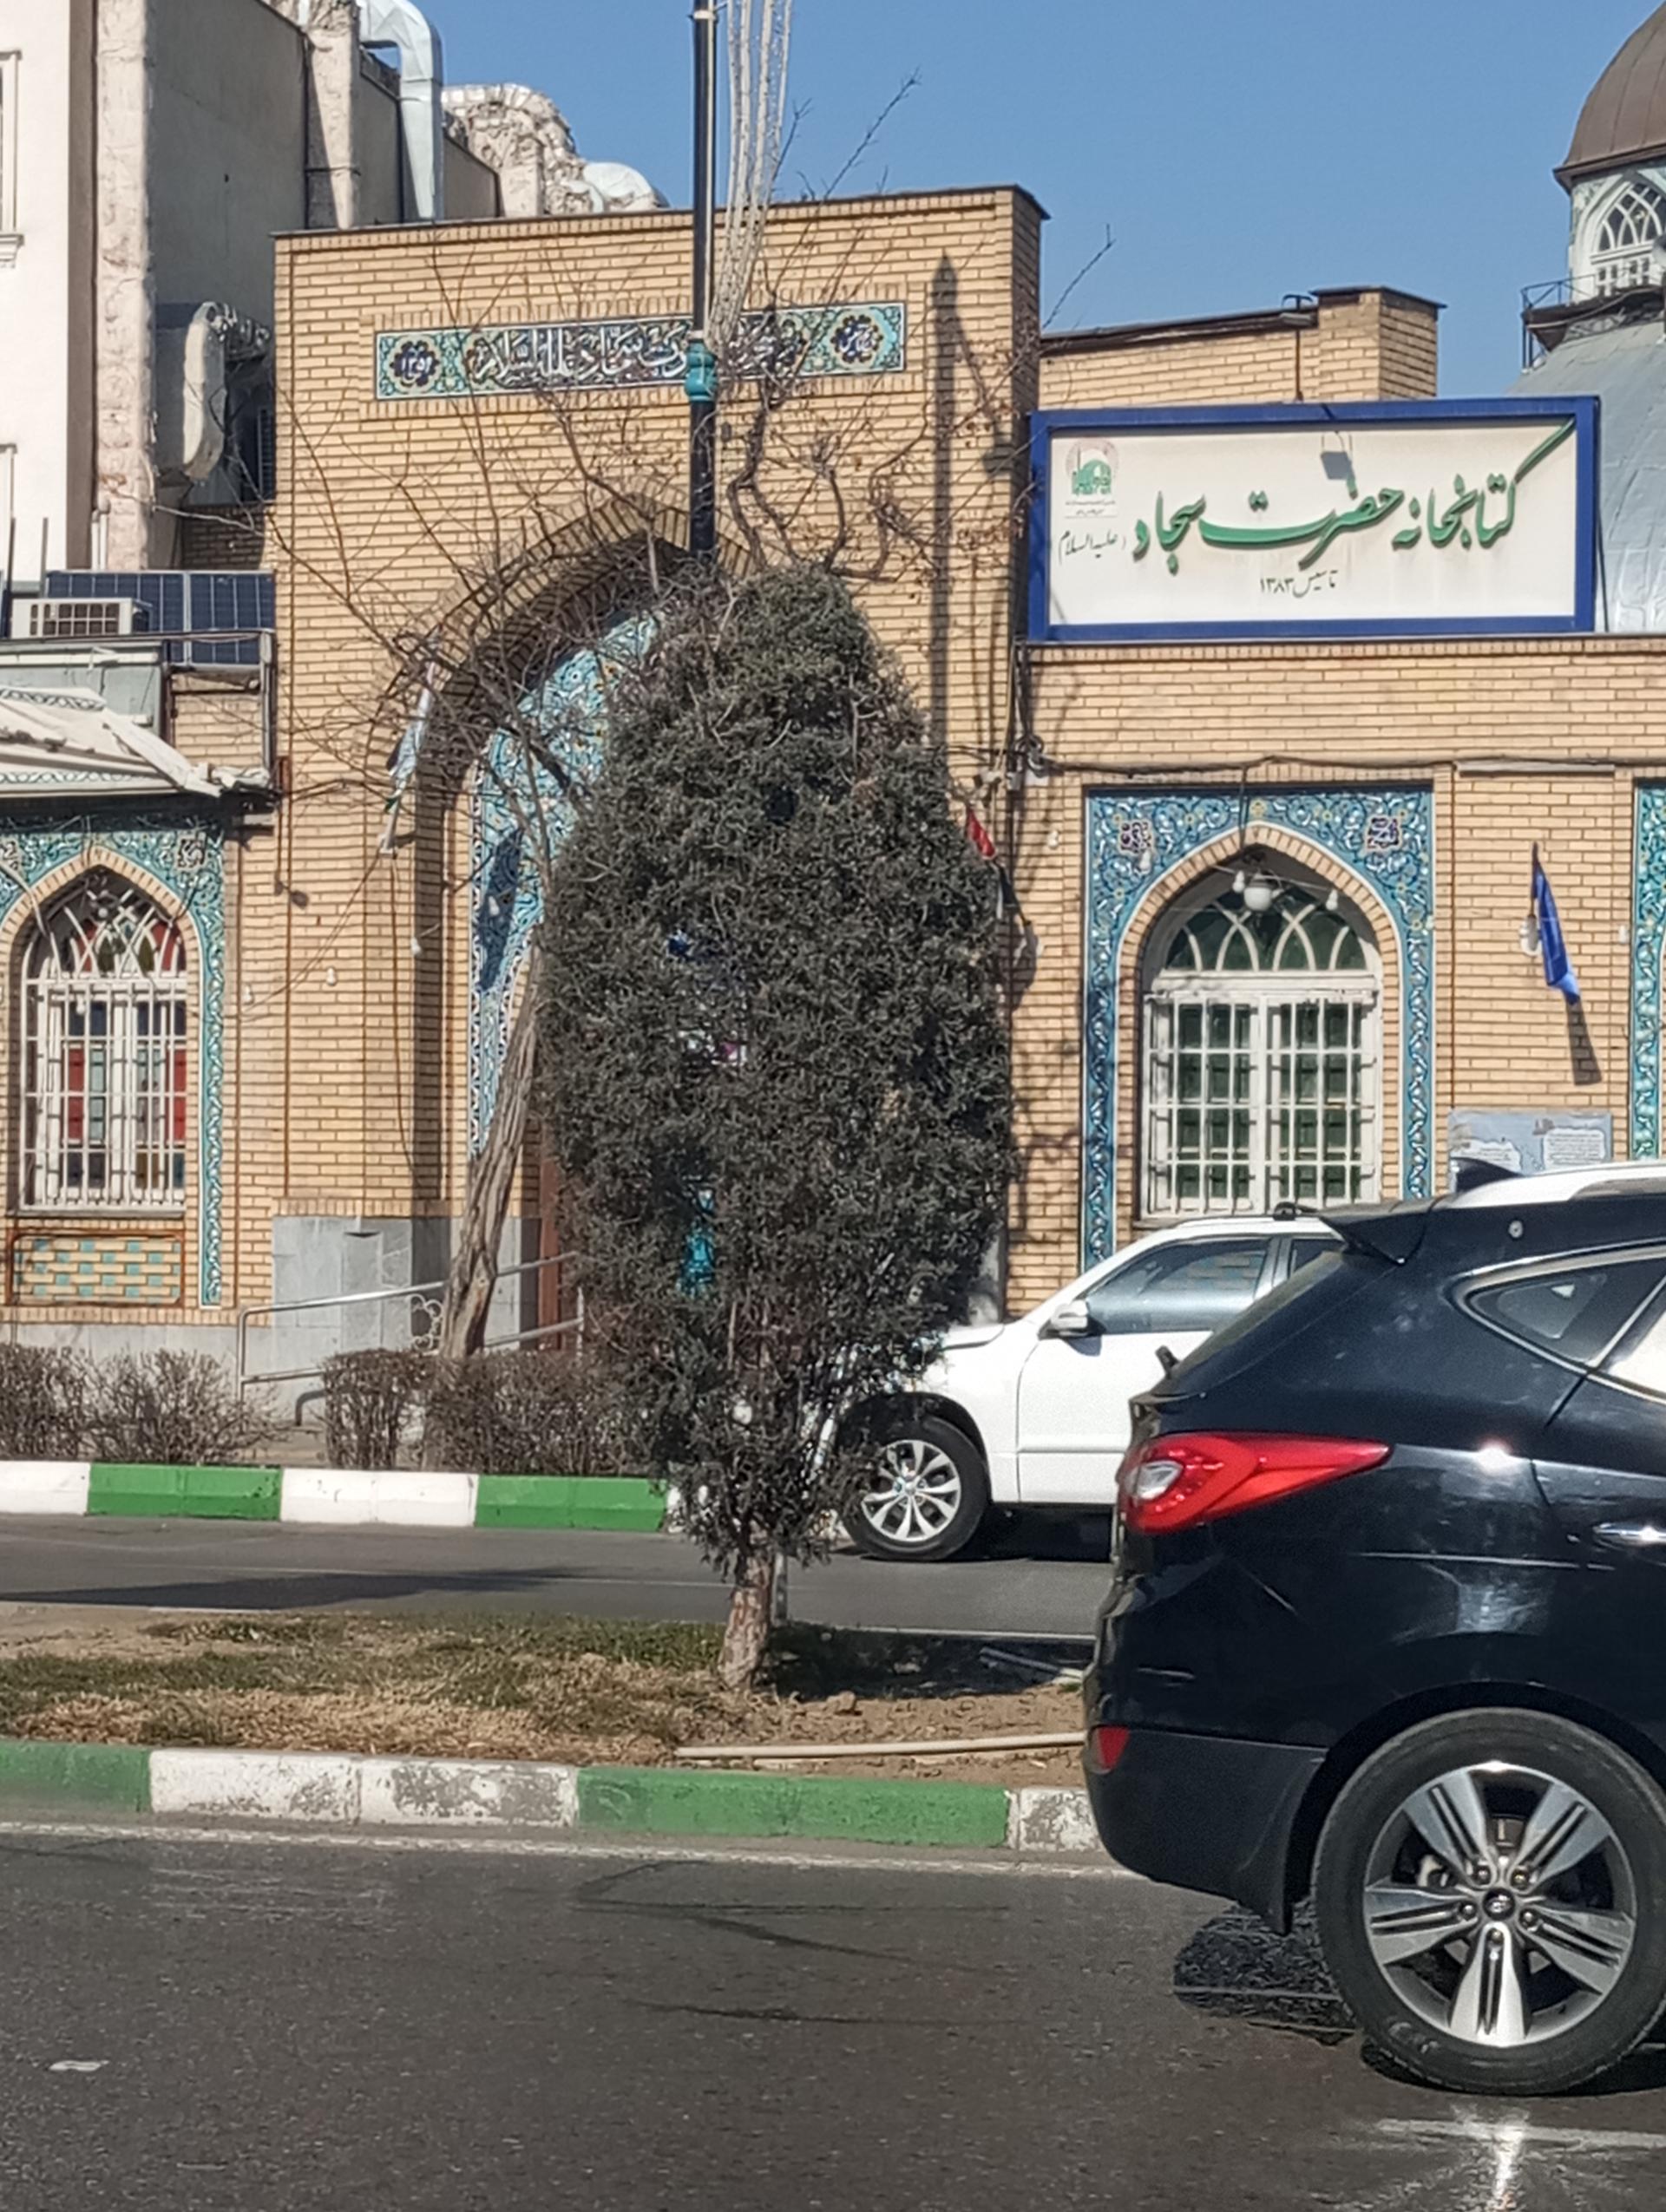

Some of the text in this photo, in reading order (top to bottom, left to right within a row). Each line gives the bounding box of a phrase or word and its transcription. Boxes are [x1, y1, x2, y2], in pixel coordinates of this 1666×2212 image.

[1131, 416, 1577, 575] کتابخانه حضرت سجاد
[1260, 577, 1294, 594] ۱۳۸۳
